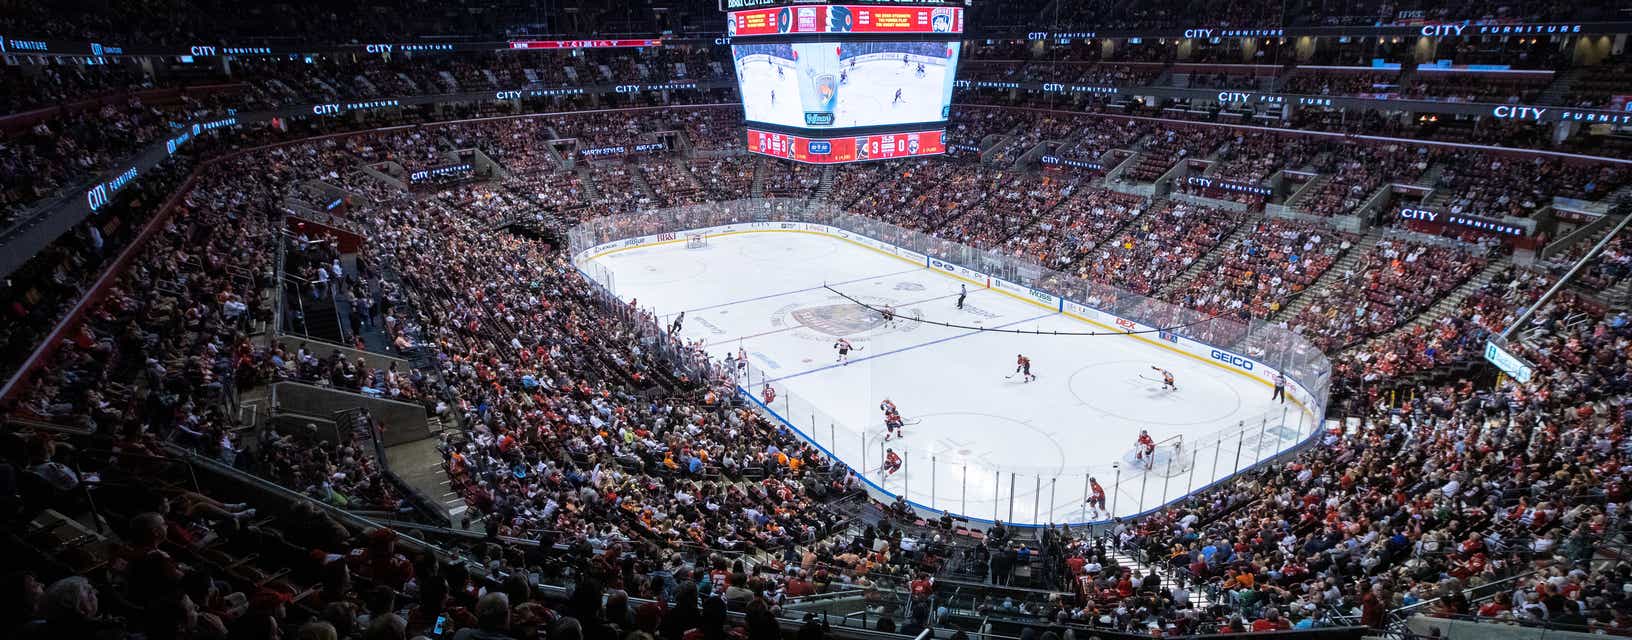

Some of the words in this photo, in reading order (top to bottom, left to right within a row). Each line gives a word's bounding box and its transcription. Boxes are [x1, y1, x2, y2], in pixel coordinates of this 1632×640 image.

[1028, 32, 1048, 40] CITY
[1184, 29, 1214, 39] CITY
[1221, 29, 1284, 37] FURNITURE
[1421, 24, 1467, 36] CITY
[1480, 25, 1582, 33] FURNITURE
[191, 46, 216, 56] CITY
[366, 44, 392, 53] CITY
[615, 84, 640, 93] CITY
[1043, 83, 1065, 91] CITY
[496, 90, 522, 100] CITY
[530, 88, 584, 96] FURNITURE
[1218, 92, 1250, 103] CITY
[313, 104, 340, 115] CITY
[347, 100, 399, 109] FURNITURE
[1493, 105, 1547, 120] CITY
[781, 140, 786, 153] 3
[872, 142, 879, 154] 3
[898, 139, 905, 152] 0
[1041, 156, 1060, 164] CITY
[1064, 160, 1101, 170] FURNITURE
[411, 170, 429, 180] CITY
[432, 164, 471, 175] FURNITURE
[1188, 177, 1212, 187] CITY
[1220, 183, 1272, 195] FURNITURE
[87, 182, 107, 211] CITY
[1401, 208, 1438, 222] CITY
[1450, 216, 1521, 236] FURNITURE
[1115, 316, 1137, 330] DEX
[1211, 349, 1253, 371] GEICO
